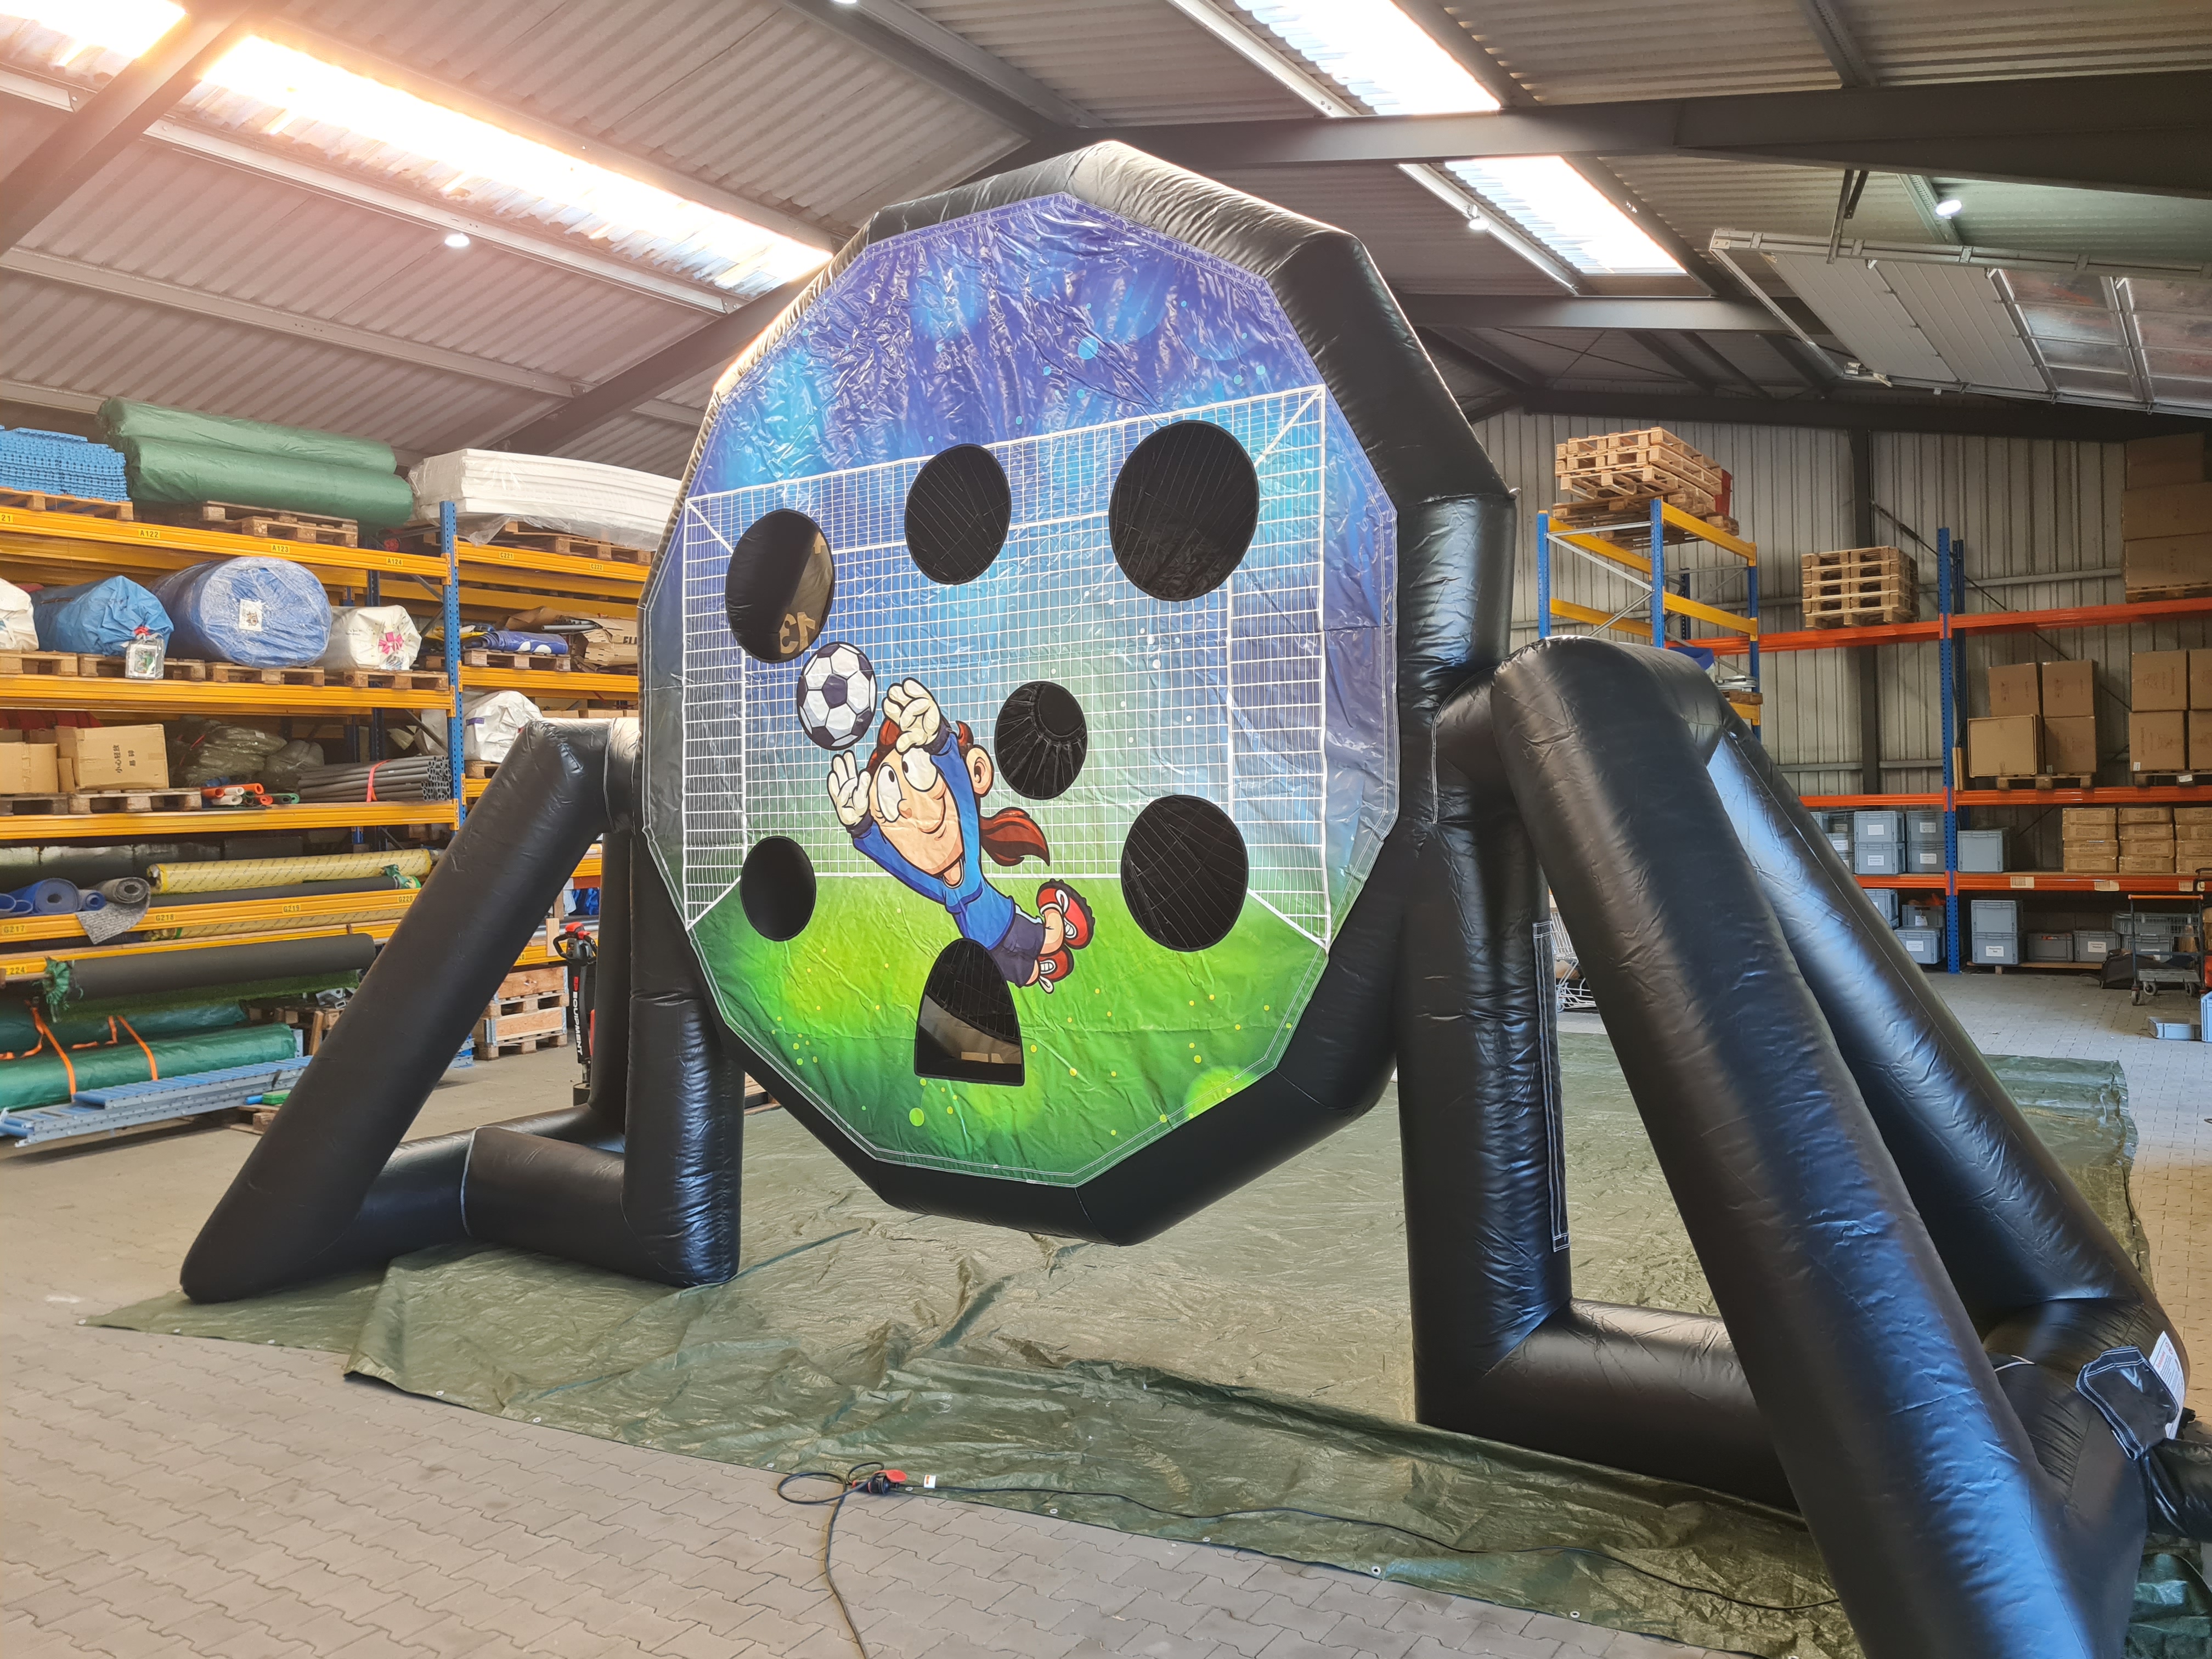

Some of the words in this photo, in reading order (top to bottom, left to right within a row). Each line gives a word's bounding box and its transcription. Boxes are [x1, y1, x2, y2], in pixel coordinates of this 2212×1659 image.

[140, 530, 159, 538] A122
[112, 744, 123, 774] 小心轻放
[3, 925, 25, 933] G217
[573, 991, 583, 1056] EQUIPMENT
